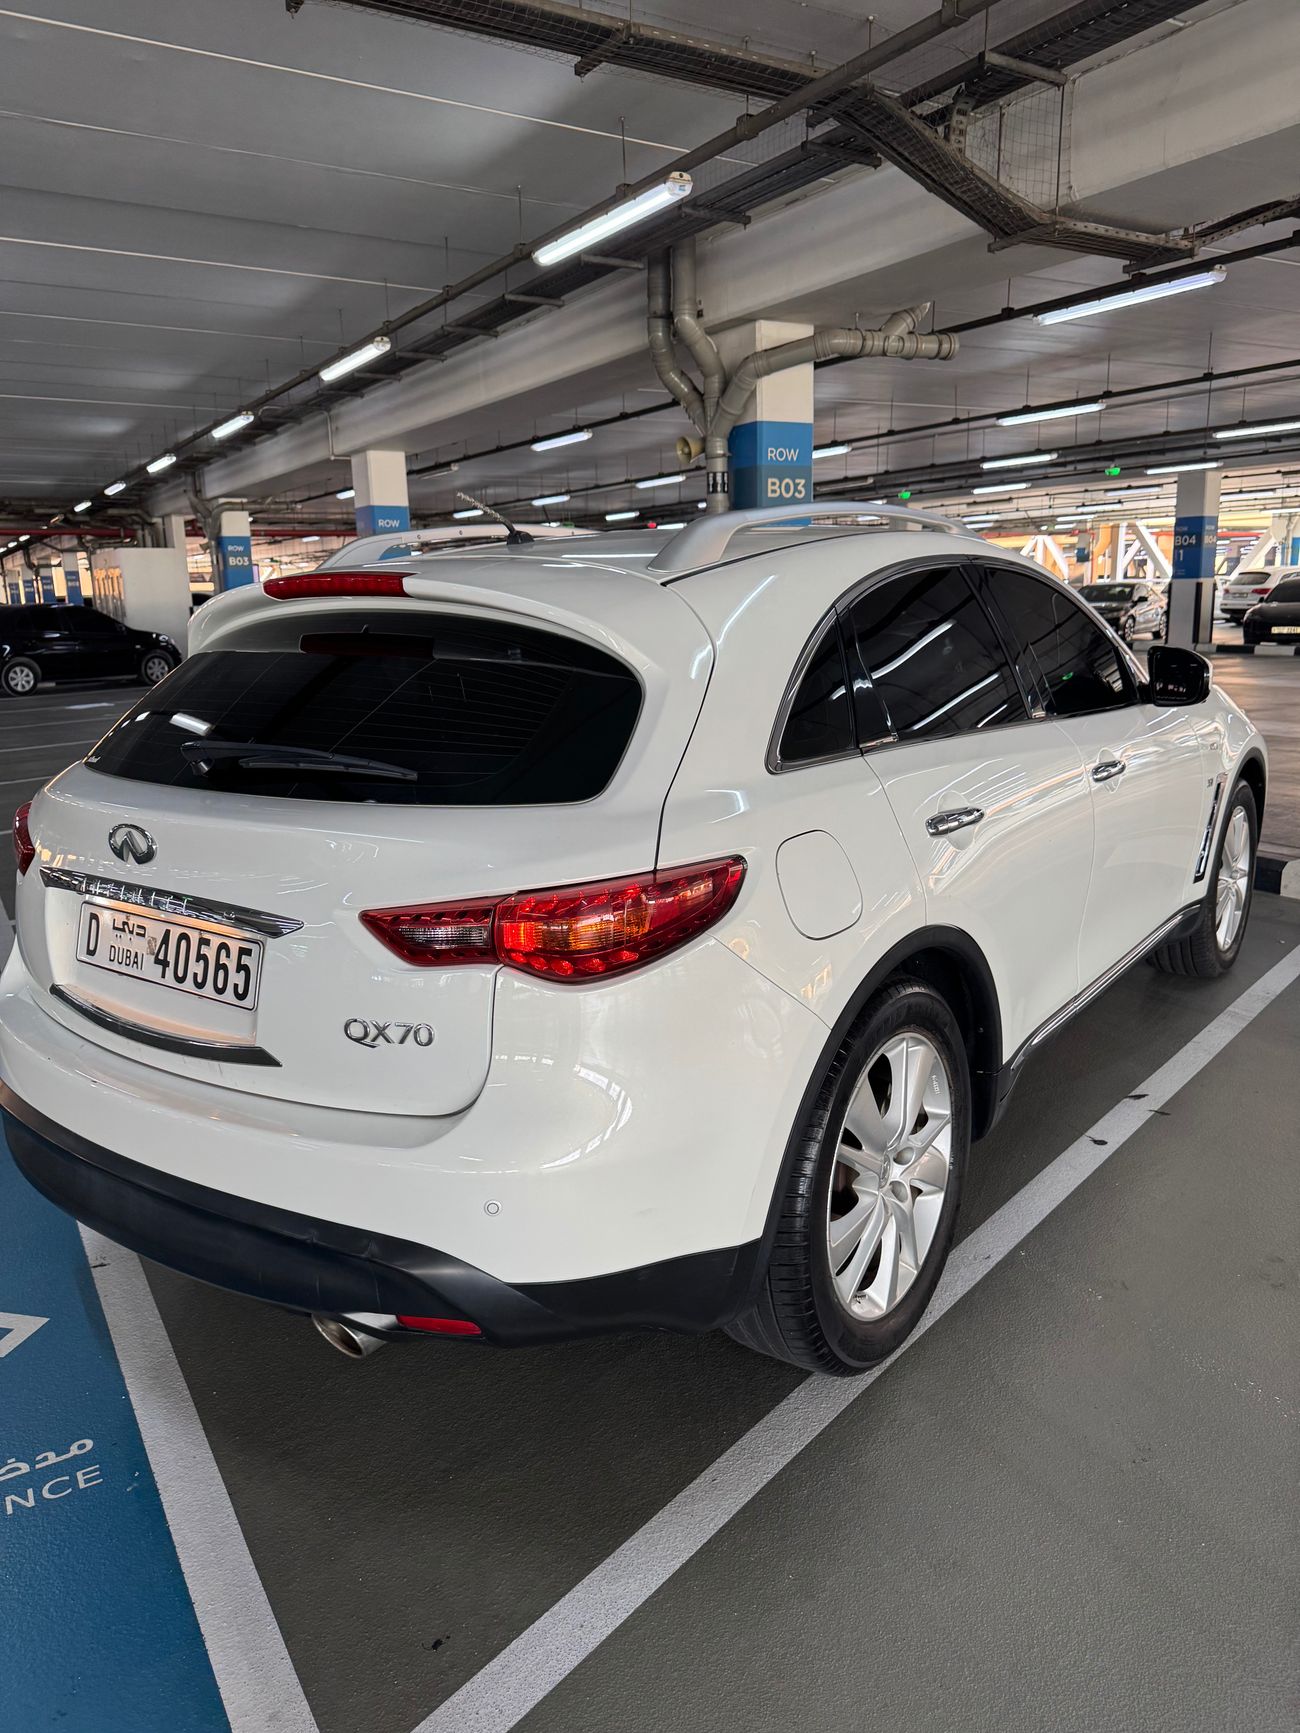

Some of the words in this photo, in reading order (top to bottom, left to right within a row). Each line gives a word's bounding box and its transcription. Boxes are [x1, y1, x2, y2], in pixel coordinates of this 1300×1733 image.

[767, 447, 799, 462] ROW
[767, 477, 806, 499] B03
[378, 519, 400, 528] ROW
[1174, 535, 1196, 546] B04
[229, 556, 249, 566] B03
[86, 912, 100, 957] D
[112, 915, 147, 943] دبي
[108, 944, 144, 971] DUBAI
[153, 928, 253, 1001] 40565
[343, 1018, 435, 1049] QX70
